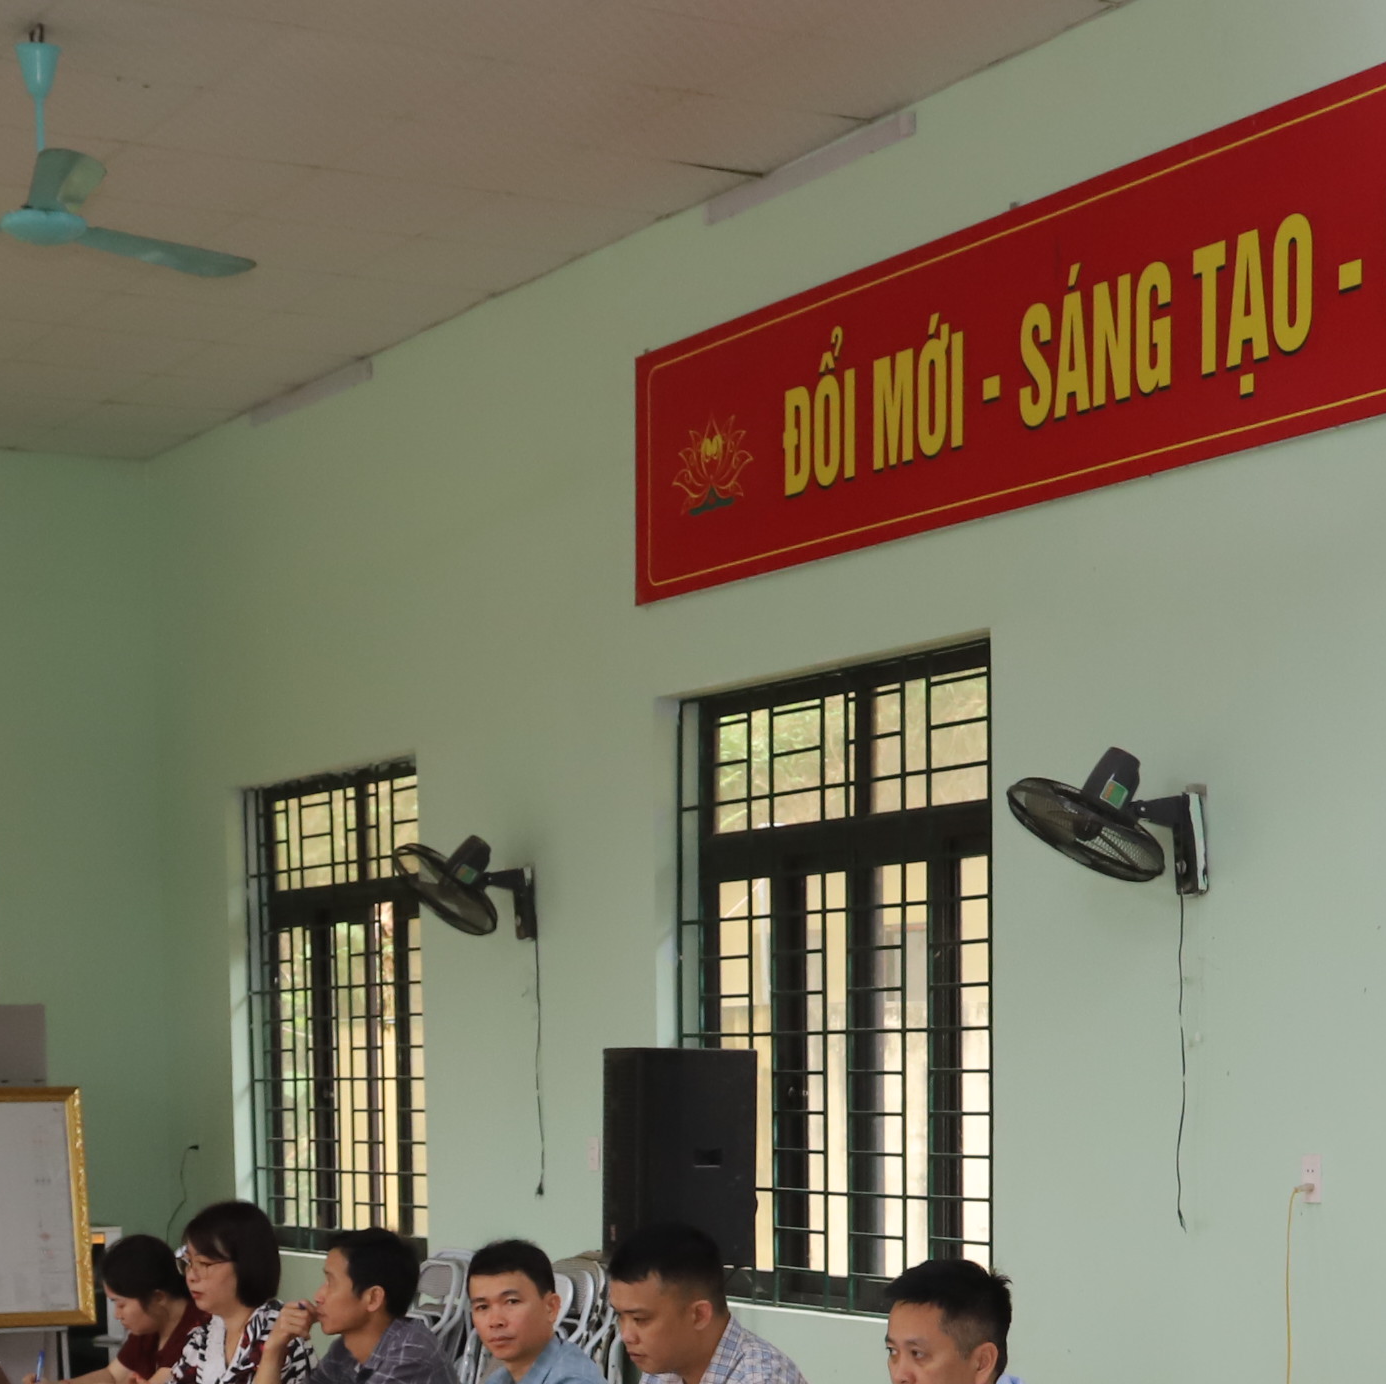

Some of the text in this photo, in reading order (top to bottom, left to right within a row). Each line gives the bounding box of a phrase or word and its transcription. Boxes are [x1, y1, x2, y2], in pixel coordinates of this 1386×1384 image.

[783, 326, 855, 498] ĐỔI
[873, 312, 963, 472] MỚI
[1019, 262, 1171, 428] SÁNG
[1193, 213, 1312, 397] TẠO
